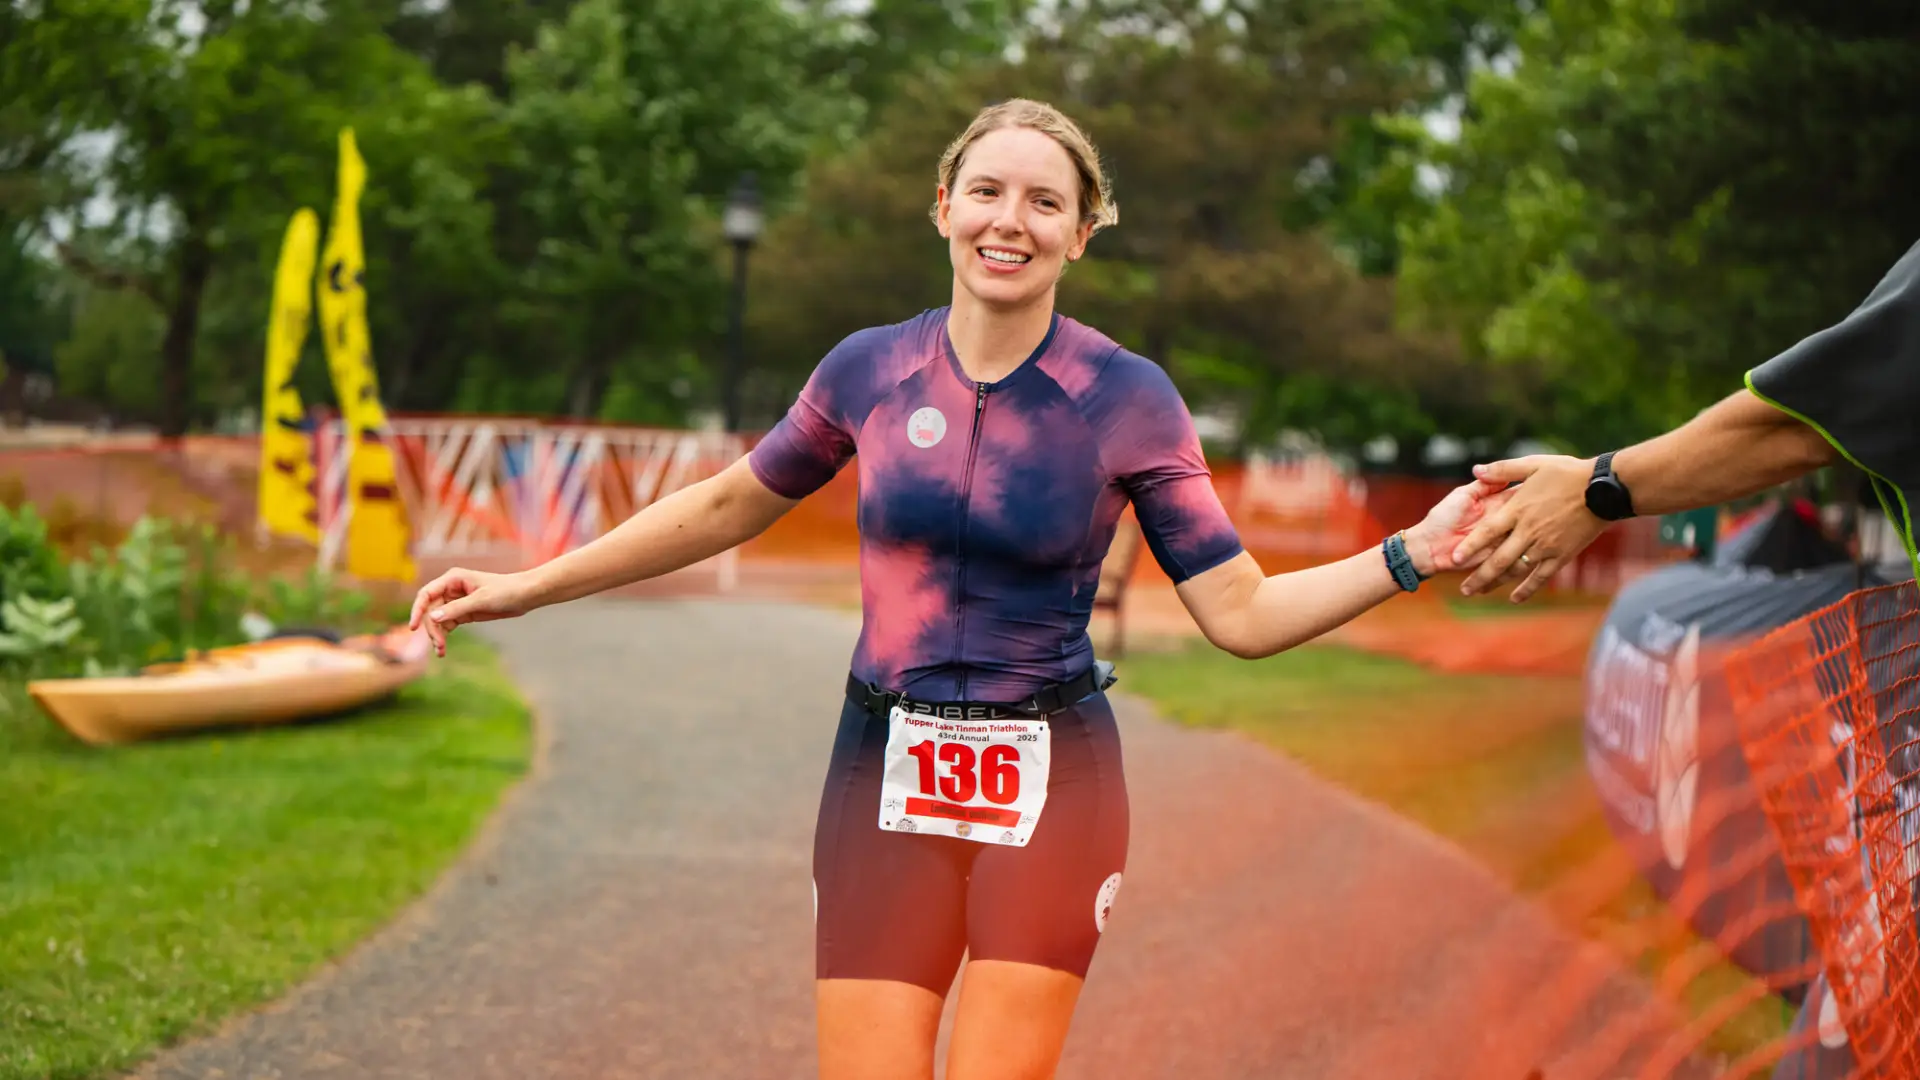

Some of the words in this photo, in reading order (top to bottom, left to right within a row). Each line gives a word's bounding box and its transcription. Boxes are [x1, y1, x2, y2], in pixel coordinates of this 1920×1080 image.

[904, 717, 934, 728] Tupper
[935, 721, 954, 731] Lake
[956, 724, 987, 733] Tinman
[989, 723, 1028, 733] Triathlon
[938, 732, 957, 740] 43rd
[959, 734, 990, 742] Annual
[1016, 734, 1038, 742] 2025
[907, 739, 1020, 805] 136
